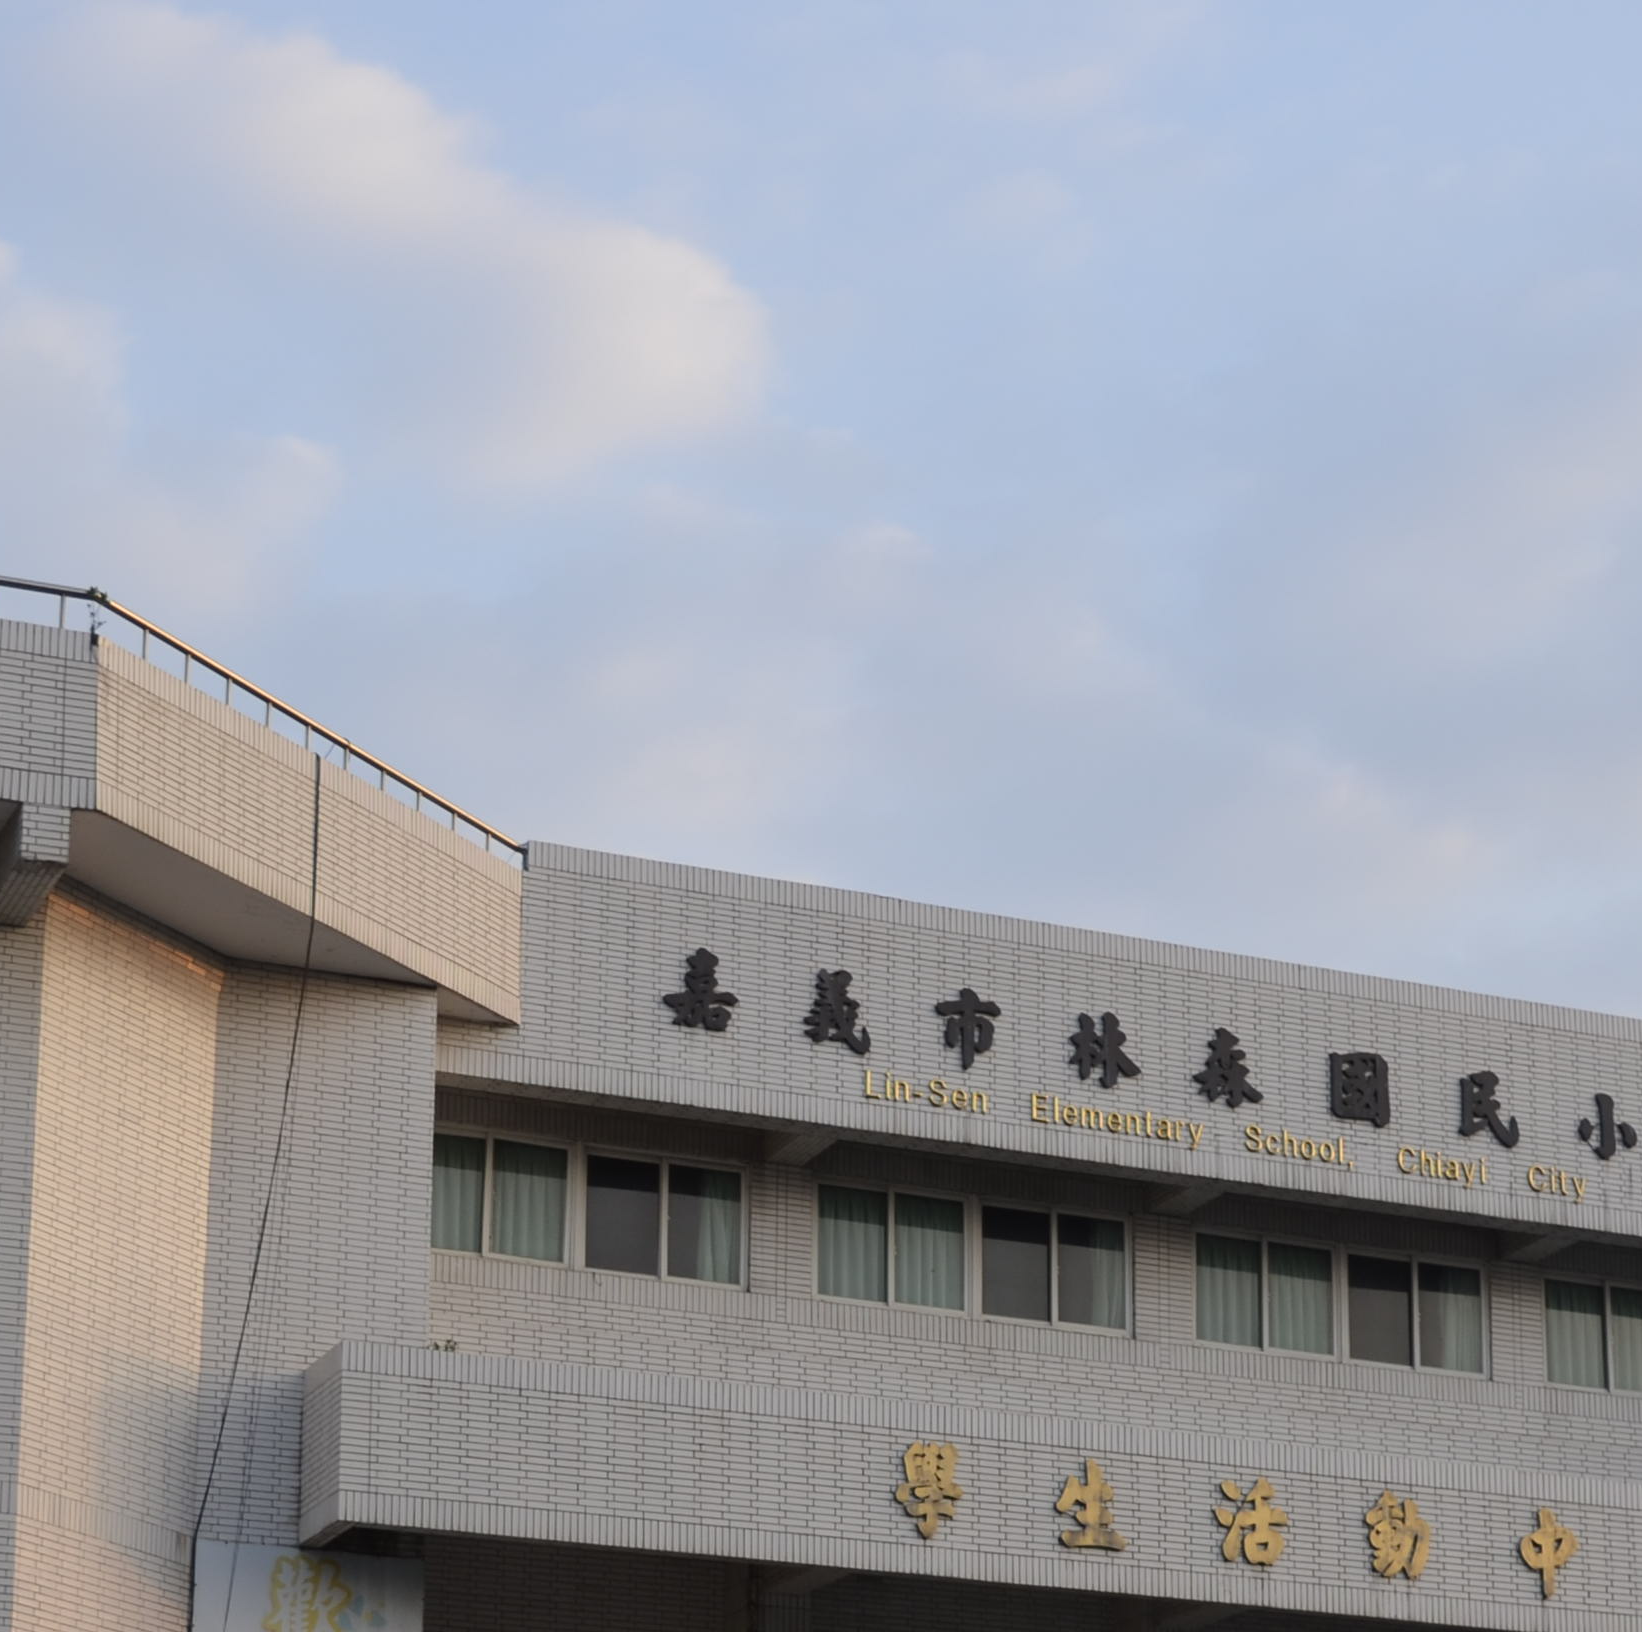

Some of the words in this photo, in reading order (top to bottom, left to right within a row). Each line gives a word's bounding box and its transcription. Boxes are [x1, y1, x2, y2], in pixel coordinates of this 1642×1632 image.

[863, 1066, 989, 1114] Lin-Sen
[1029, 1091, 1205, 1149] Elementary
[1244, 1122, 1356, 1170] School,
[1396, 1144, 1489, 1190] Chiayi
[1528, 1161, 1588, 1203] City
